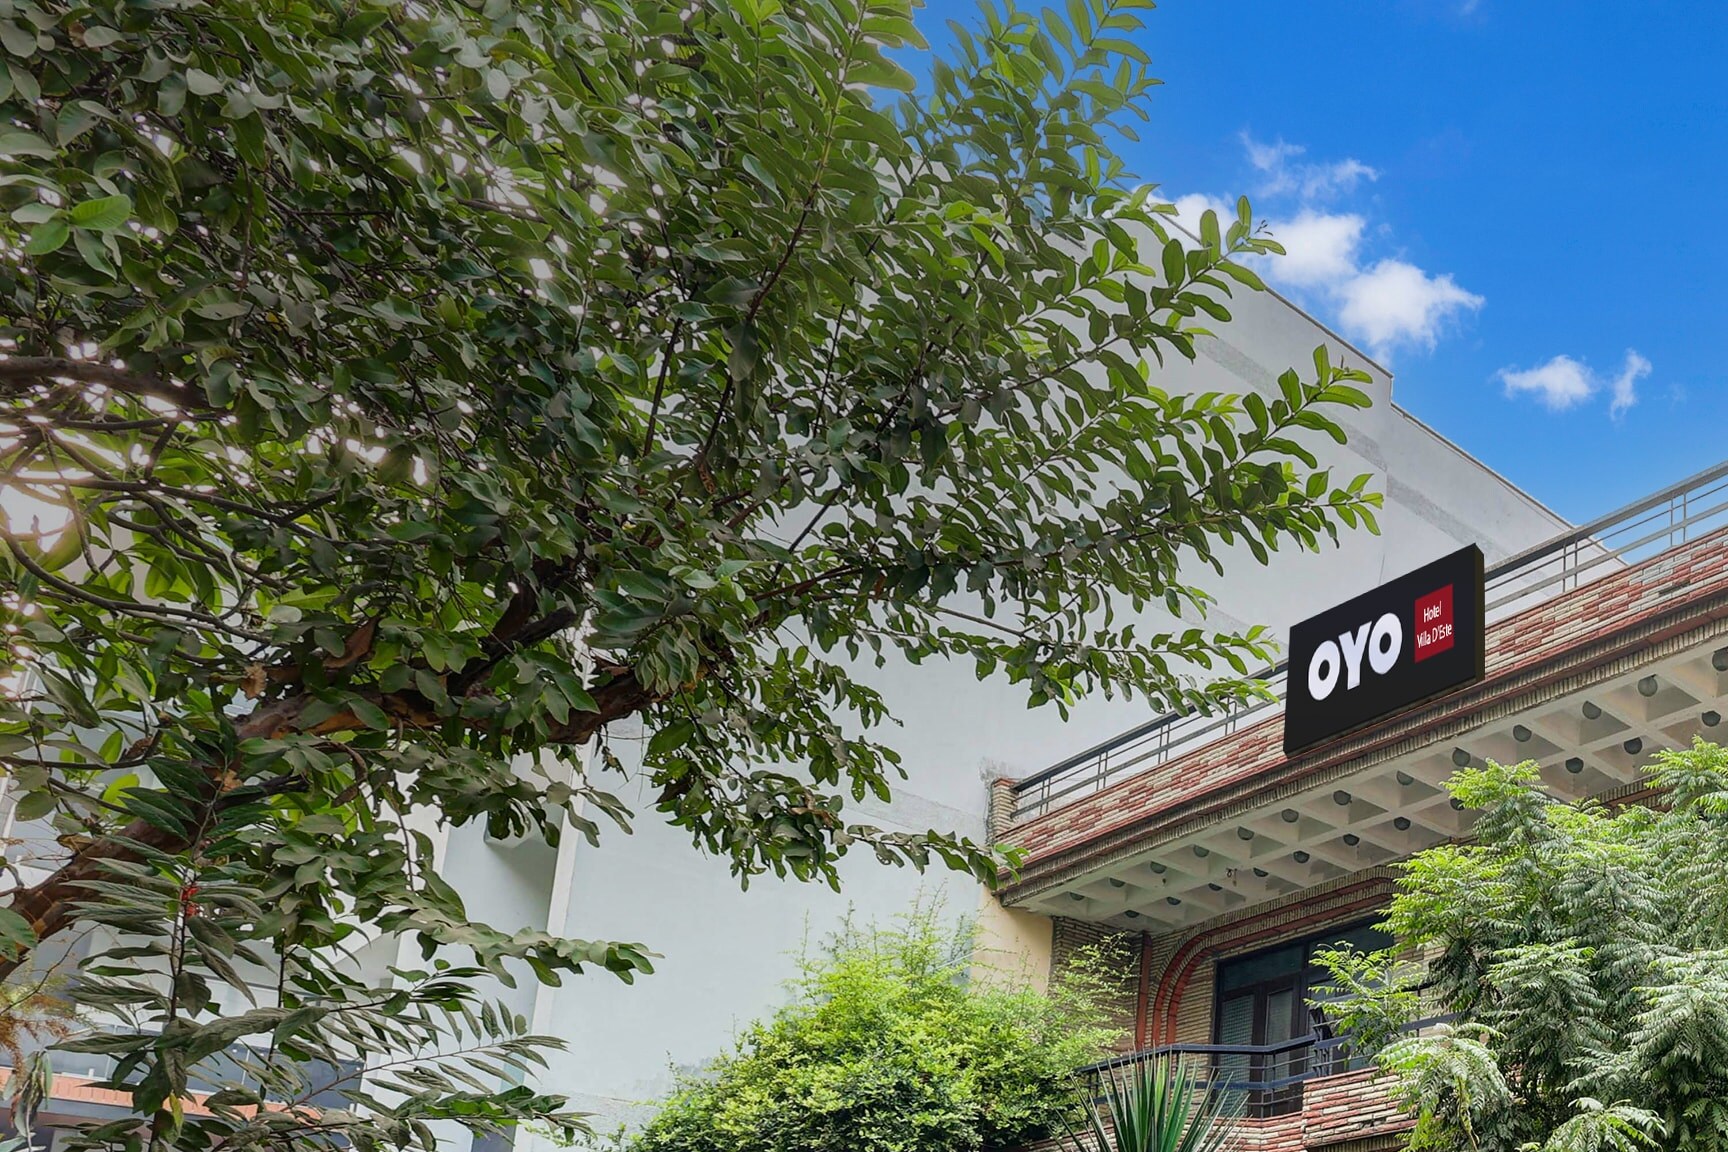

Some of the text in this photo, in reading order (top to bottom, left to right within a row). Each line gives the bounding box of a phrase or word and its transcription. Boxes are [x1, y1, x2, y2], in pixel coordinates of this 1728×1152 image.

[1423, 600, 1442, 623] Hotel
[1416, 622, 1453, 649] Villa D'Este
[1308, 612, 1402, 701] OYO
